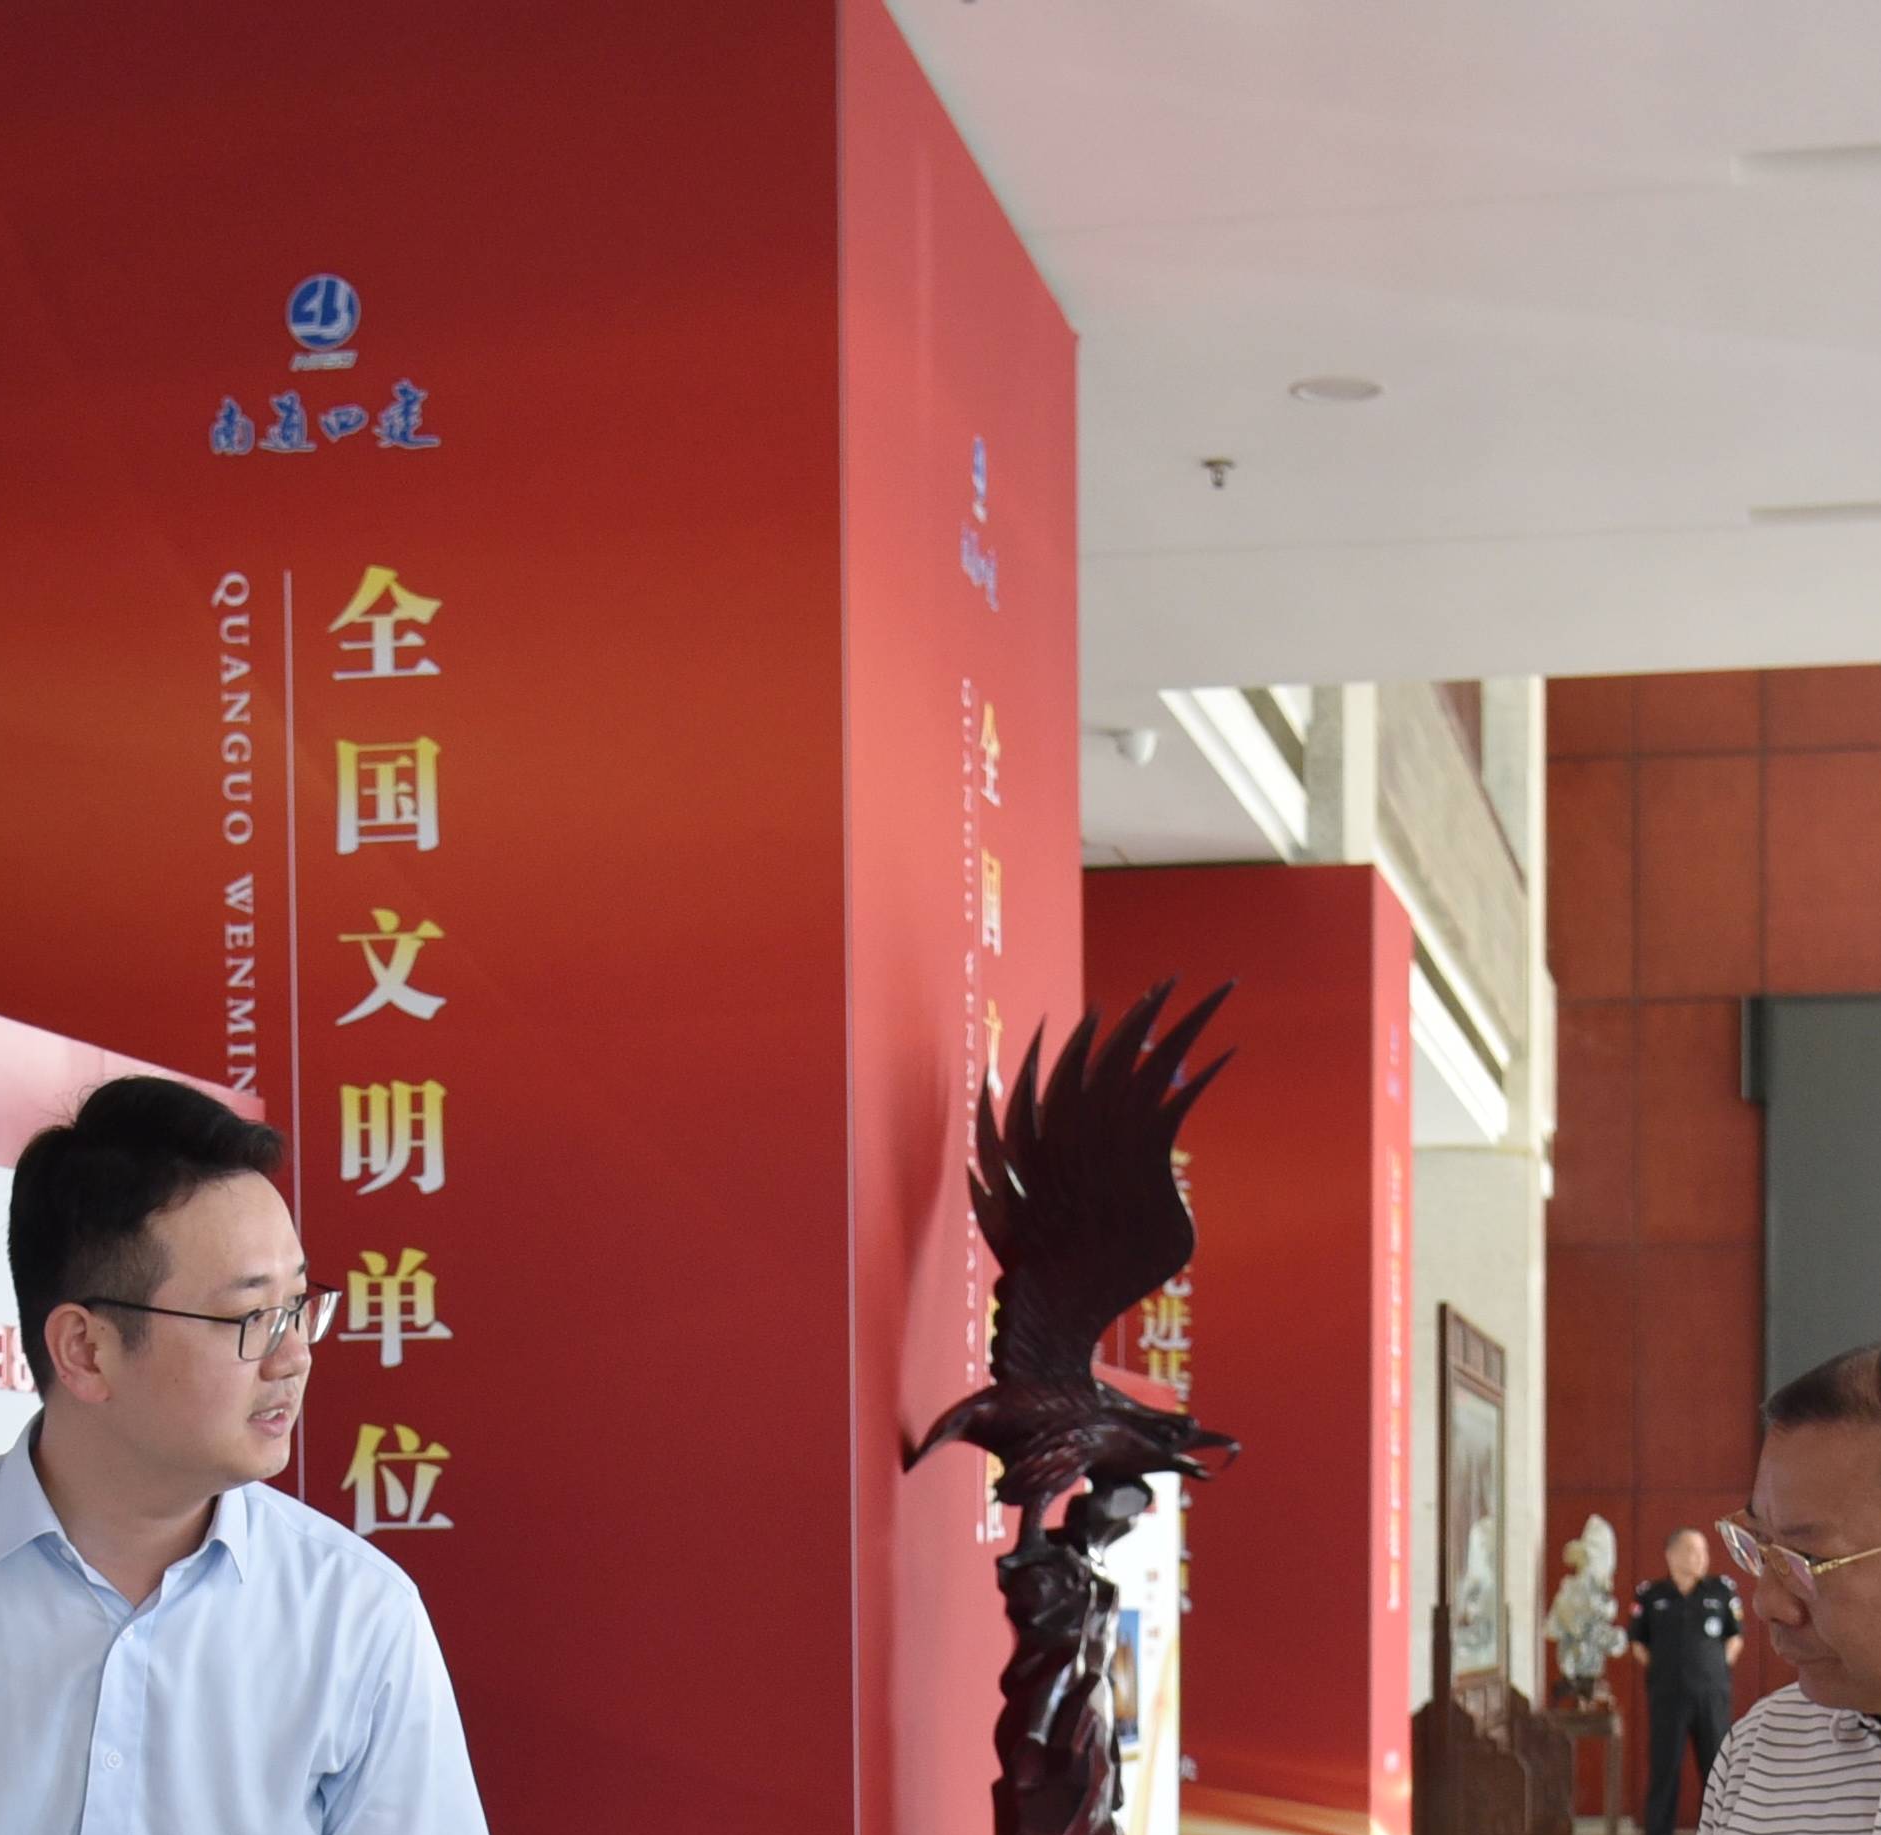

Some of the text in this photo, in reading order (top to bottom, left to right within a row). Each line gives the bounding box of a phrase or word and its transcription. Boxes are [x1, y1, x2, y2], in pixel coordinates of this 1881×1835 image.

[212, 570, 253, 847] QUANGUO
[327, 564, 455, 1538] 全国文明单位
